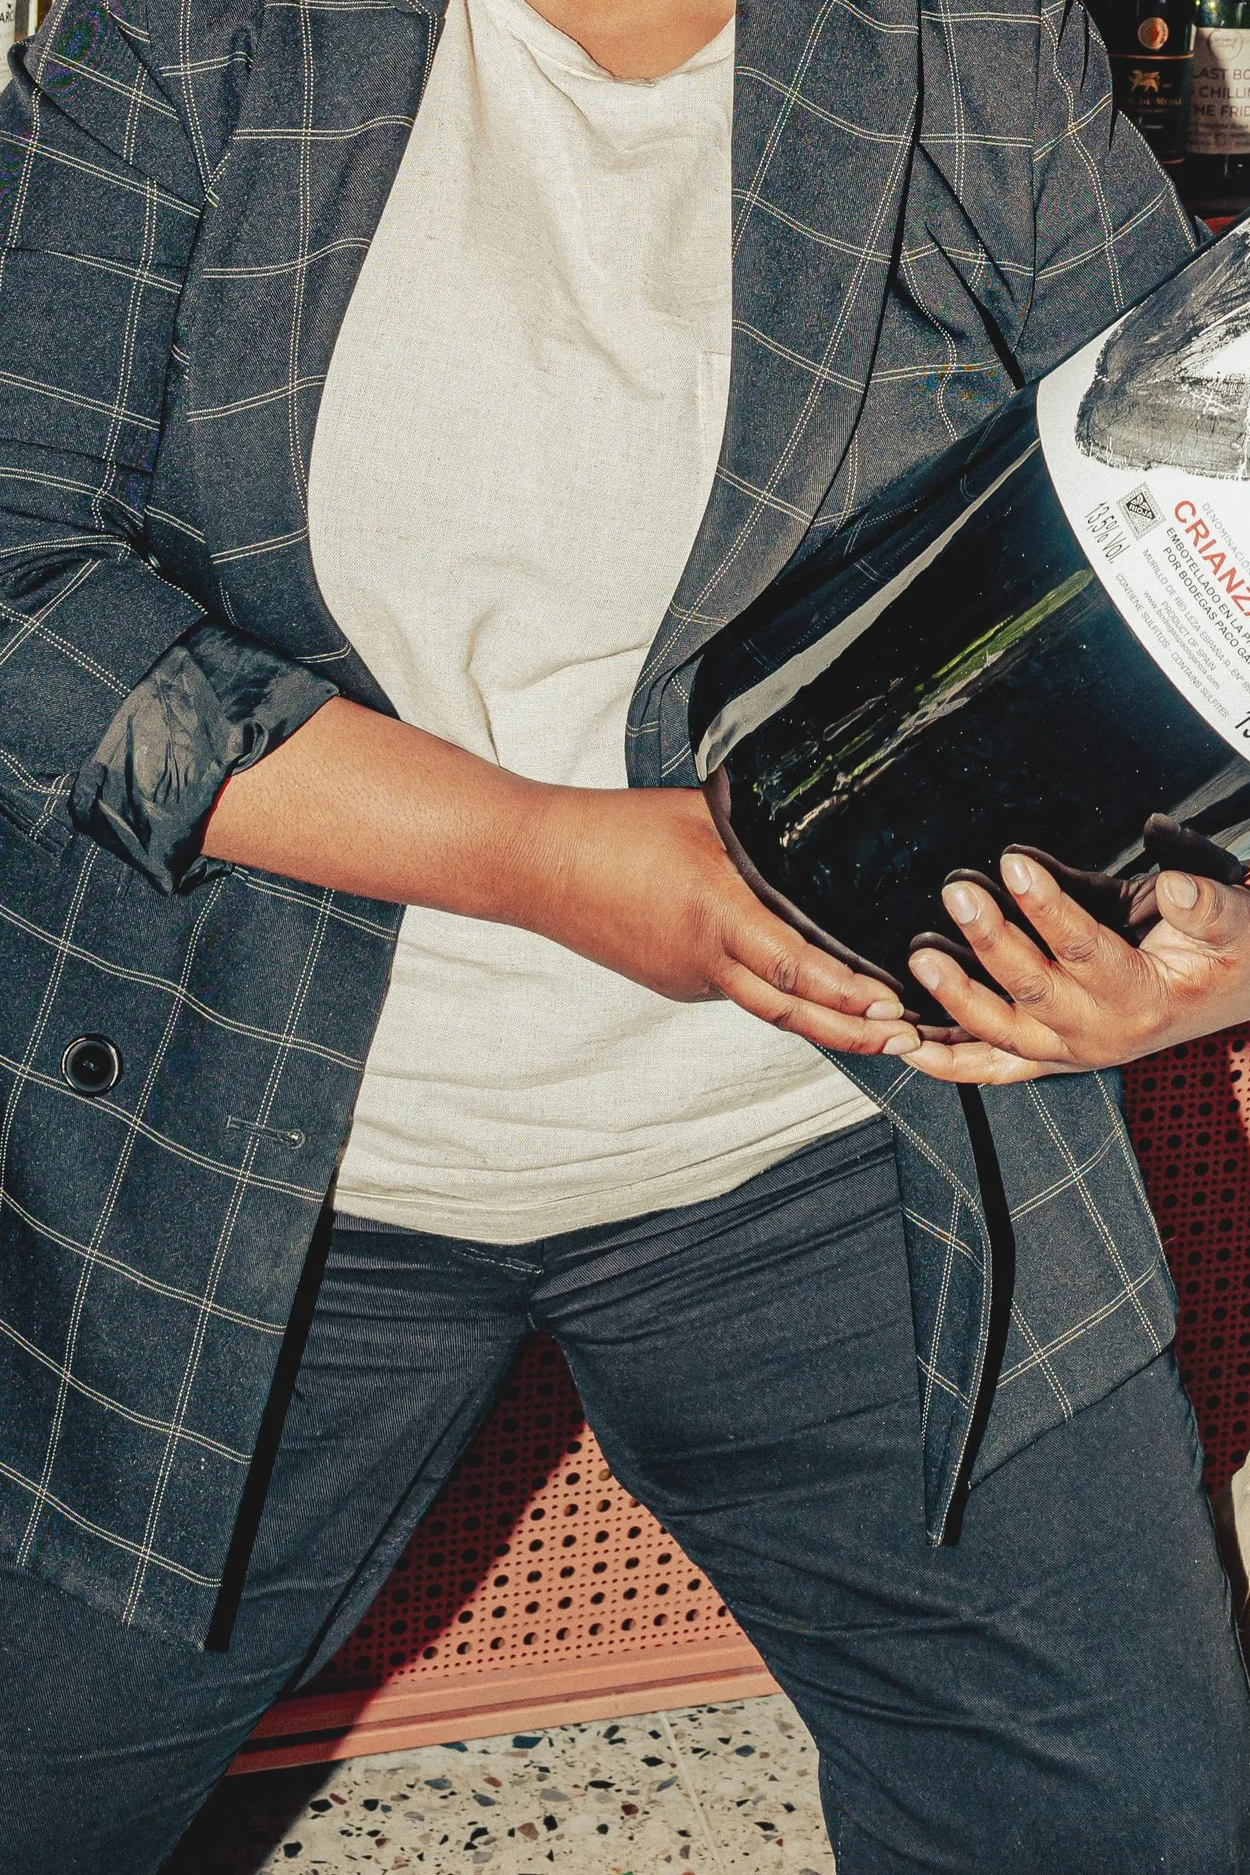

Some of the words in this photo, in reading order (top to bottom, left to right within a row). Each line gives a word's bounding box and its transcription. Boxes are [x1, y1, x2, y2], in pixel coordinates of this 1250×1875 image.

[1102, 531, 1131, 565] Vol.
[1128, 504, 1153, 519] RIOJA
[1142, 548, 1168, 586] MURILLO
[1165, 585, 1177, 597] DE
[1184, 612, 1200, 633] LEZA
[1163, 546, 1182, 571] POR
[1178, 570, 1217, 621] BODEGAS
[1216, 618, 1239, 647] PACO
[1166, 527, 1221, 602] EMBOTELLADO
[1219, 603, 1233, 619] EN
[1230, 618, 1242, 634] LA
[1116, 572, 1144, 614] CONTIENE
[1141, 612, 1169, 649] SULFITOS
[1171, 652, 1203, 688] CONTAINS
[1200, 687, 1230, 718] SULFITES
[1161, 600, 1189, 638] PRODUCT
[1187, 637, 1198, 651] OF
[1196, 648, 1217, 672] SPAIN
